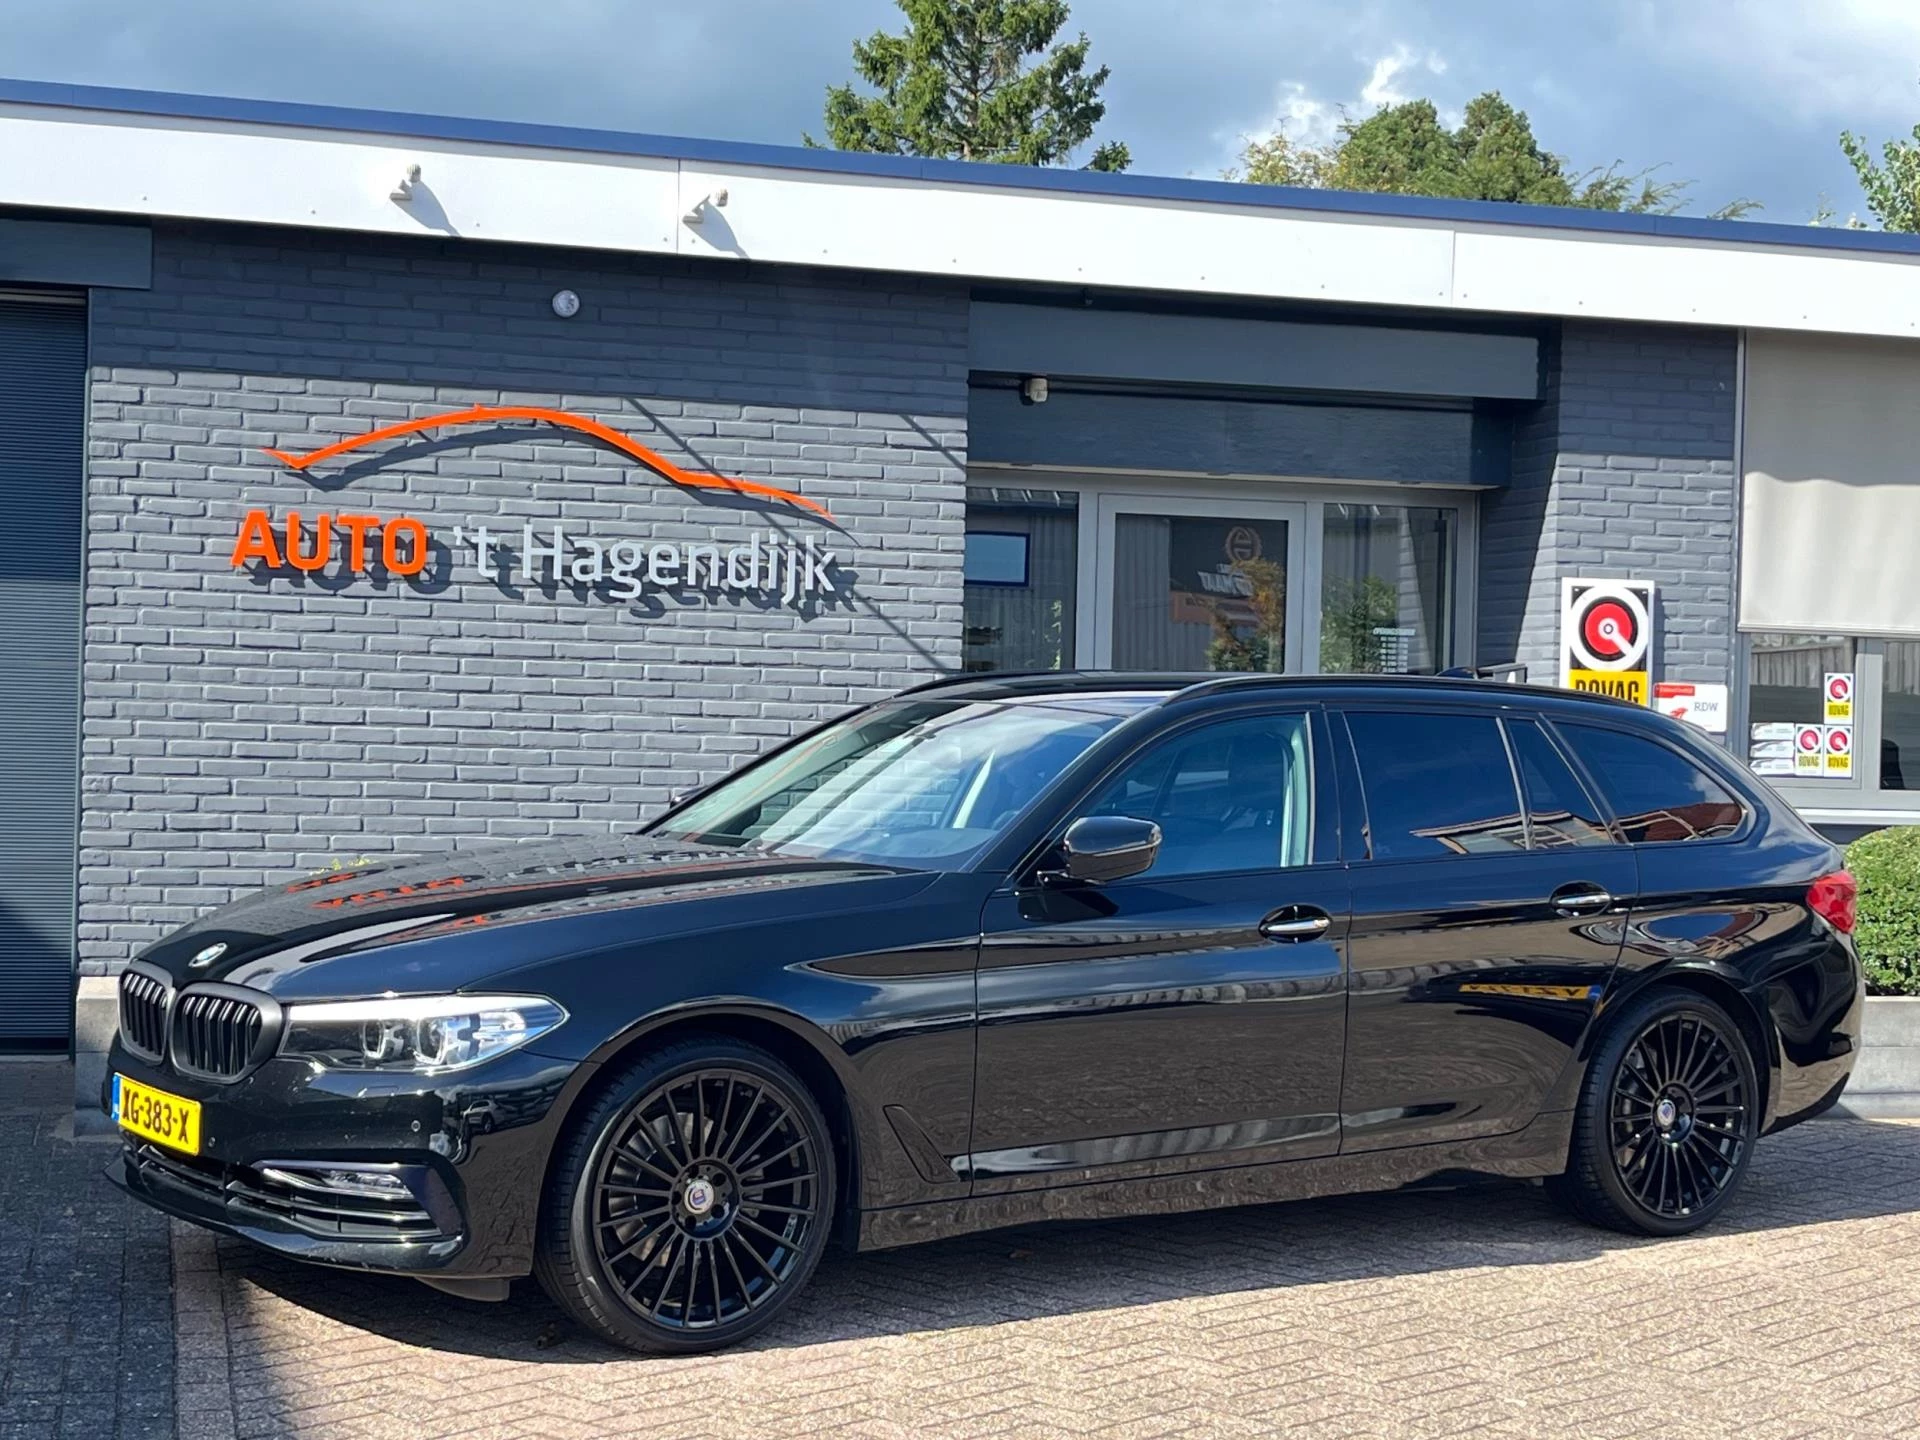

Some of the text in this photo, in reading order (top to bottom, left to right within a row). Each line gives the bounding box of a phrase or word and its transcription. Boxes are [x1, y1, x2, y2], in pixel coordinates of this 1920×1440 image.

[230, 510, 835, 604] AUTO 't Hagendijk
[1693, 702, 1719, 712] RDW
[122, 1086, 190, 1145] XG-383-X
